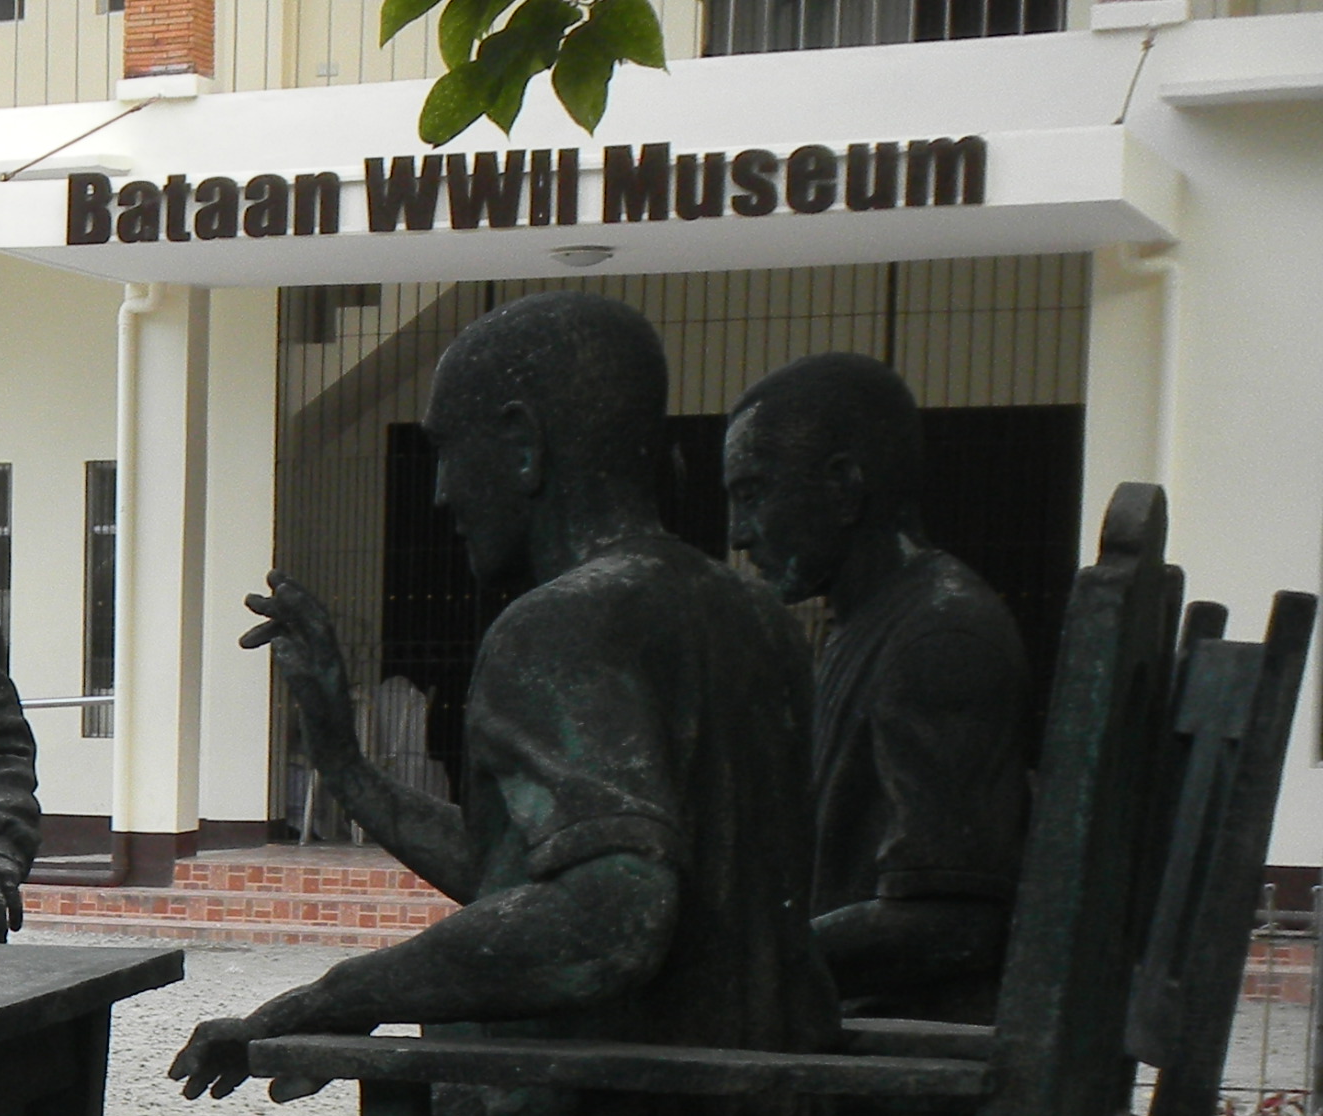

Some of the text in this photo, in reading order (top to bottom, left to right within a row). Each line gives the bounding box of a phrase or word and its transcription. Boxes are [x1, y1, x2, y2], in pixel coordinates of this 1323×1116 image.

[67, 134, 989, 246] Bataan WWII Museum
